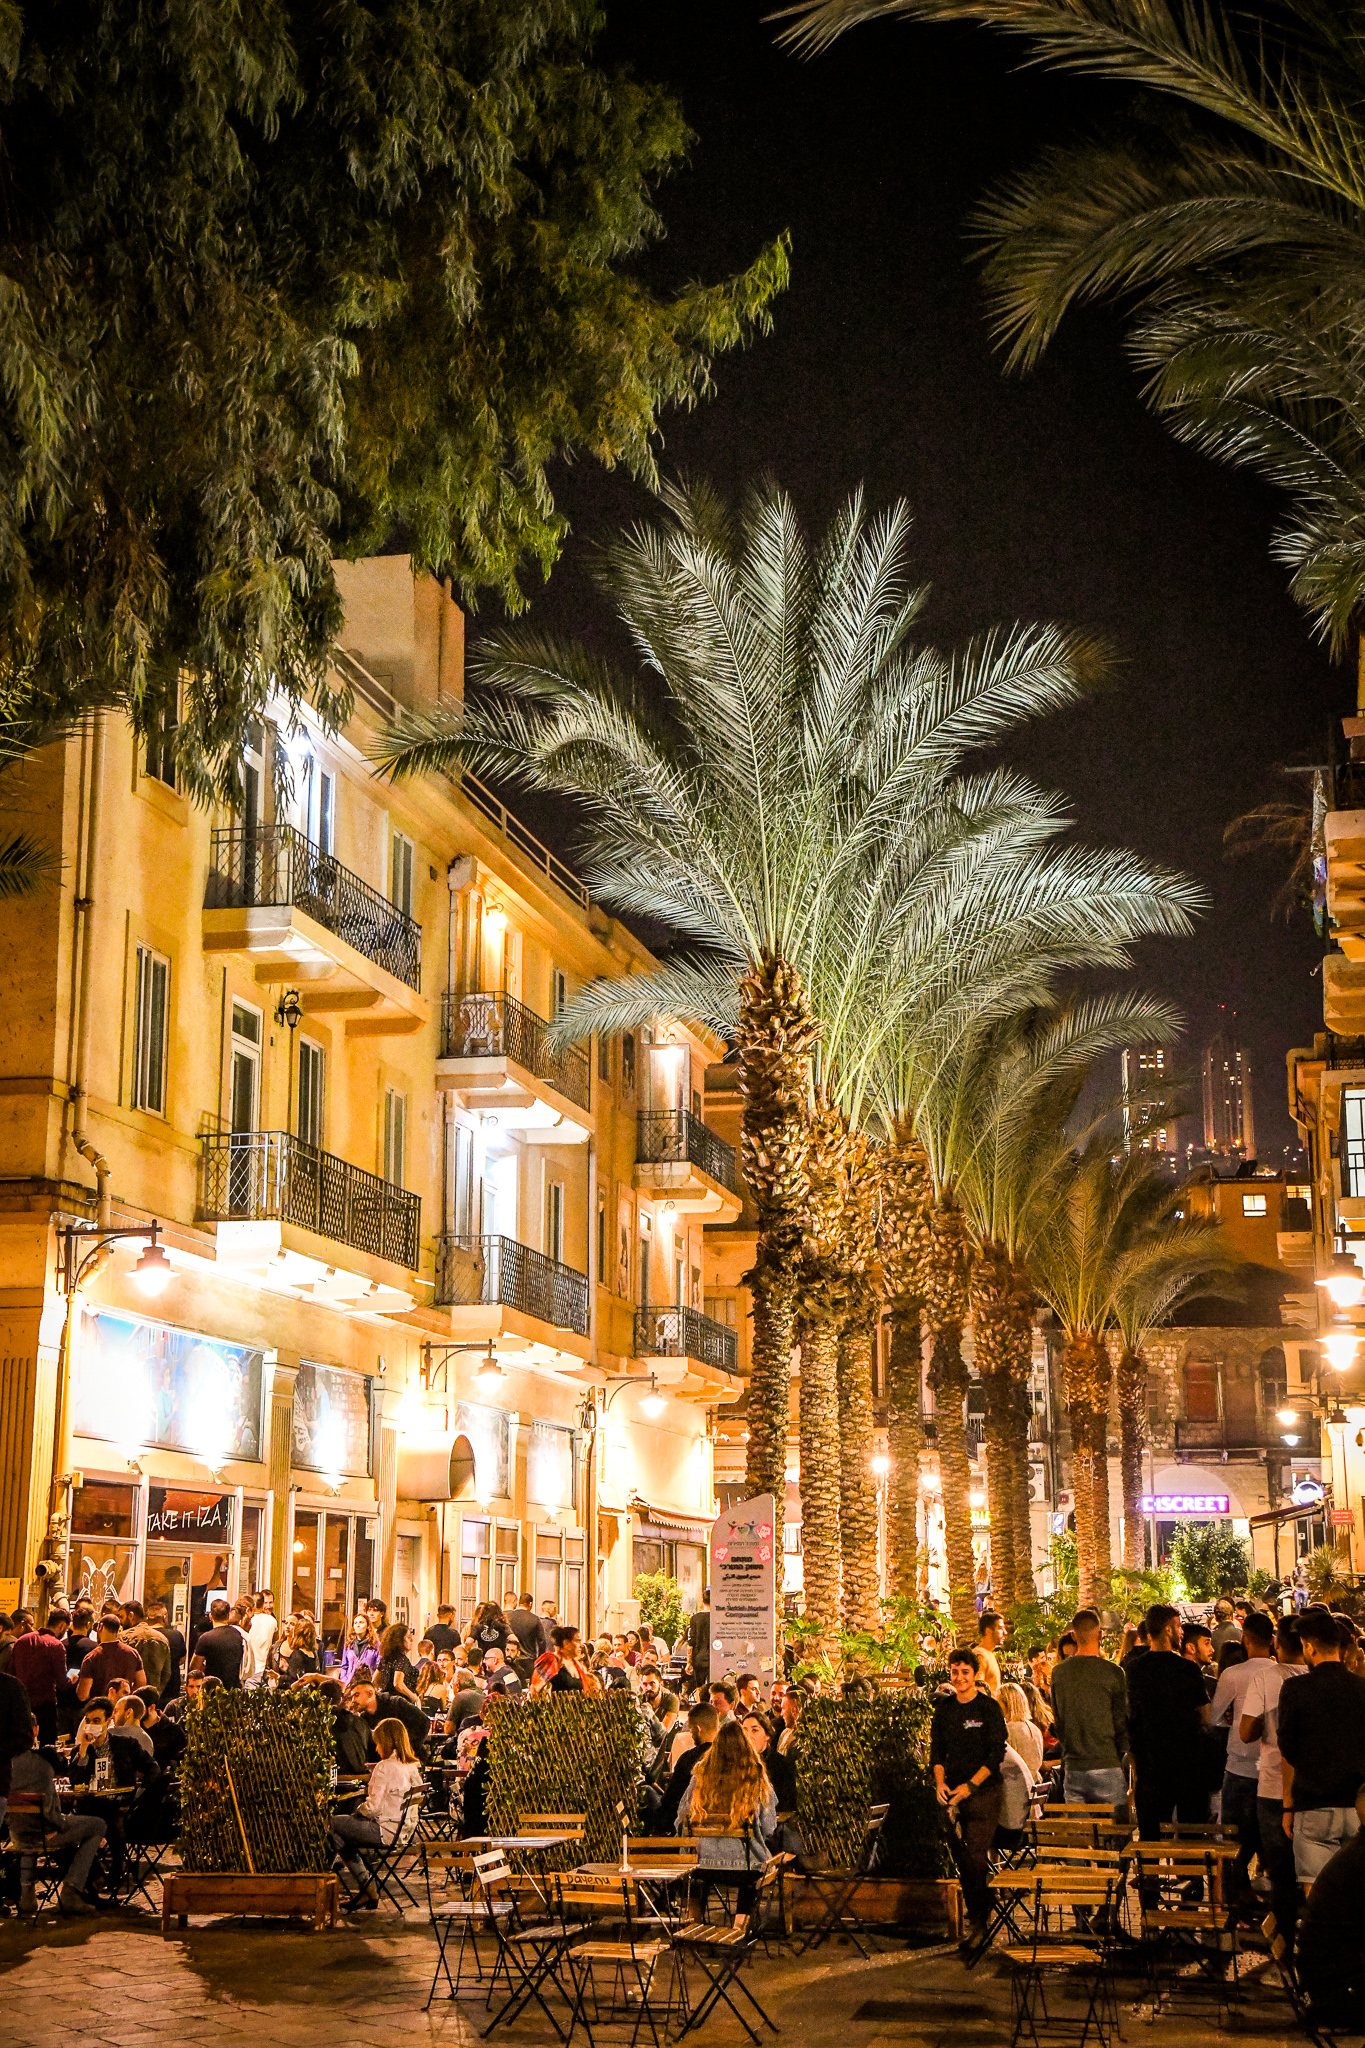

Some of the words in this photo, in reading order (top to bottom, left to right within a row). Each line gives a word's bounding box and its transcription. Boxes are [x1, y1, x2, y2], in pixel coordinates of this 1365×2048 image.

[1142, 1496, 1228, 1512] DISCREET
[147, 1510, 178, 1531] TAKE
[182, 1510, 194, 1528] IT
[196, 1504, 221, 1528] IZA
[97, 1761, 107, 1772] 38
